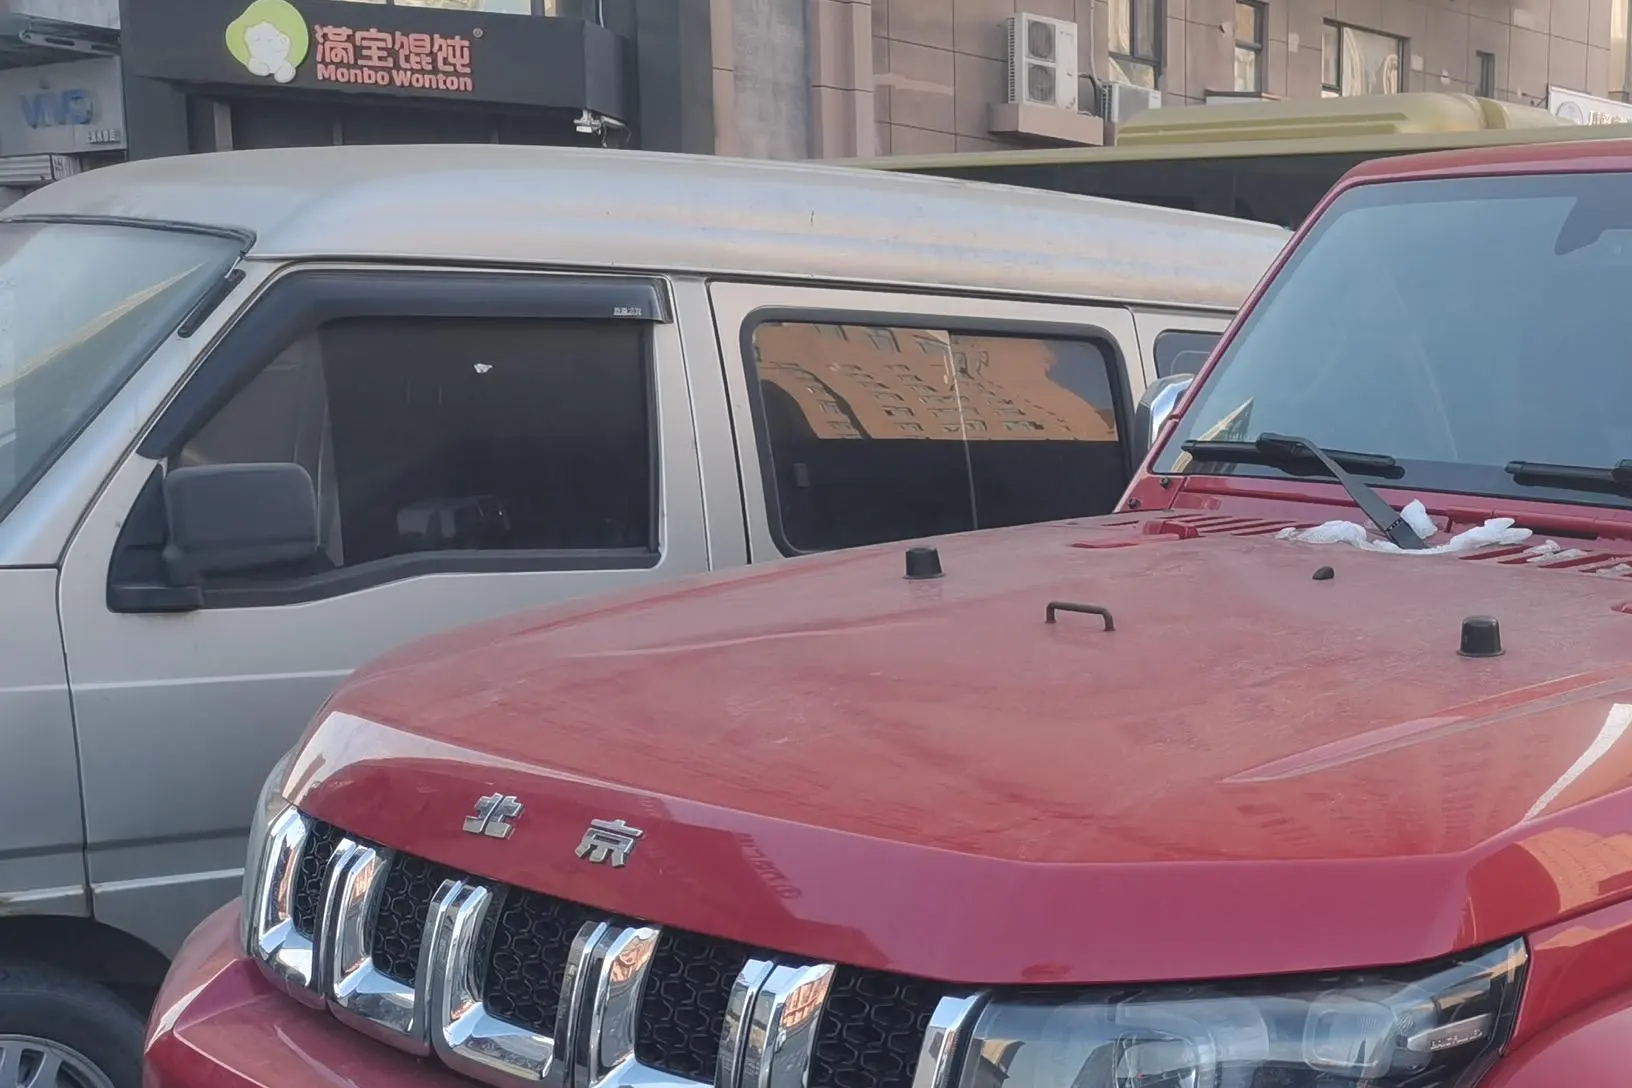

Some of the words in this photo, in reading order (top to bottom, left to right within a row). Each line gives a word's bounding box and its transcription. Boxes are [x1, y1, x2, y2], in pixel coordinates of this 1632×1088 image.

[314, 24, 471, 74] 满宝馄饨
[316, 64, 390, 85] Monbo
[392, 69, 473, 91] Wonton
[462, 792, 645, 868] 北京
